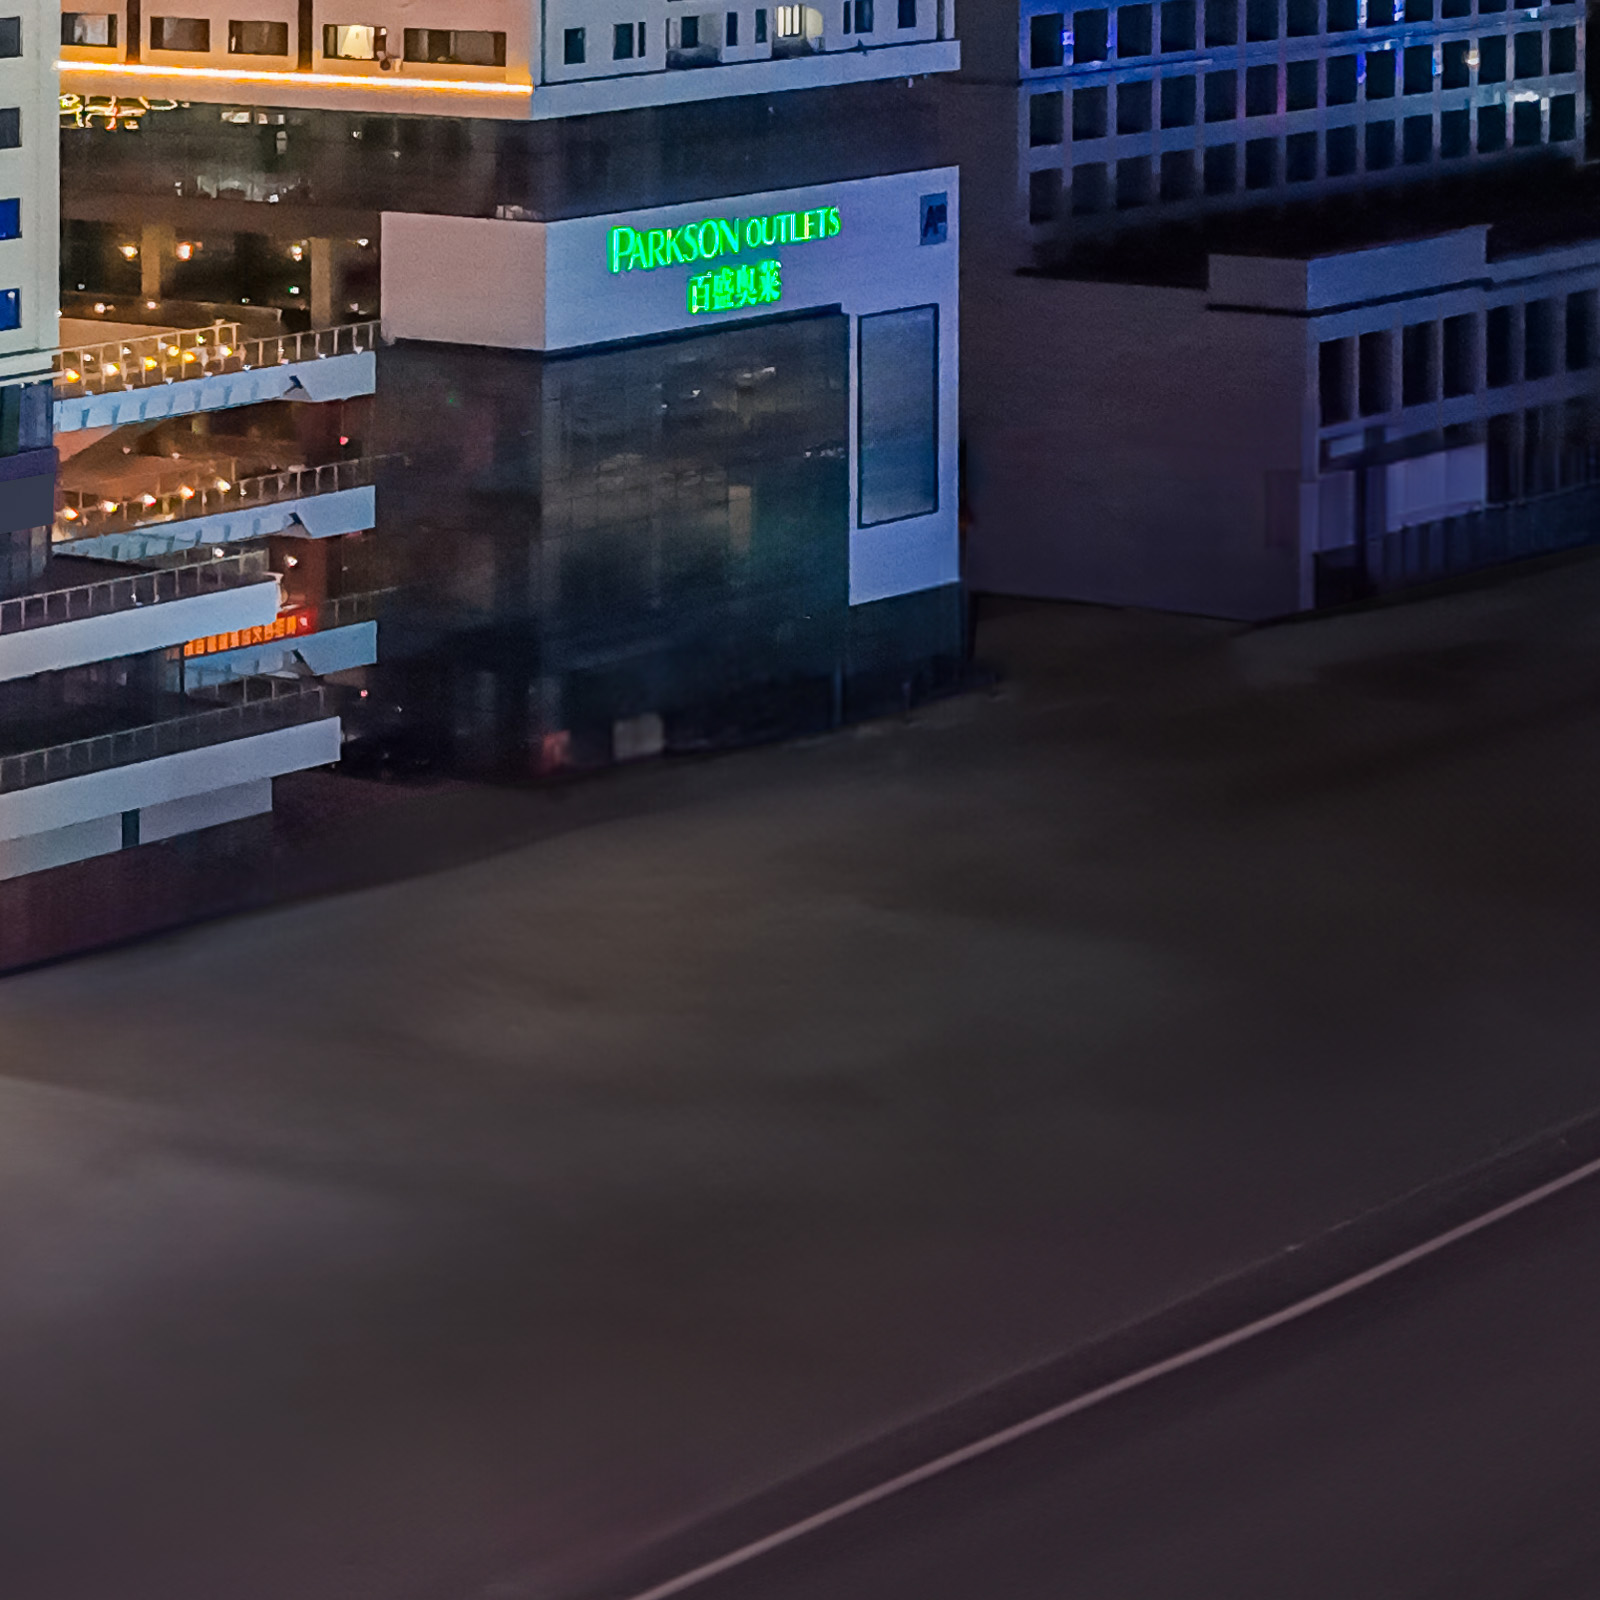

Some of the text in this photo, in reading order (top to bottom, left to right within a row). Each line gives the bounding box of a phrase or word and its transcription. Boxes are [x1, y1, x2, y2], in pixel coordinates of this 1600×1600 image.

[608, 206, 842, 274] PARKSON OUTLETS
[688, 259, 782, 315] 百盛奥莱
